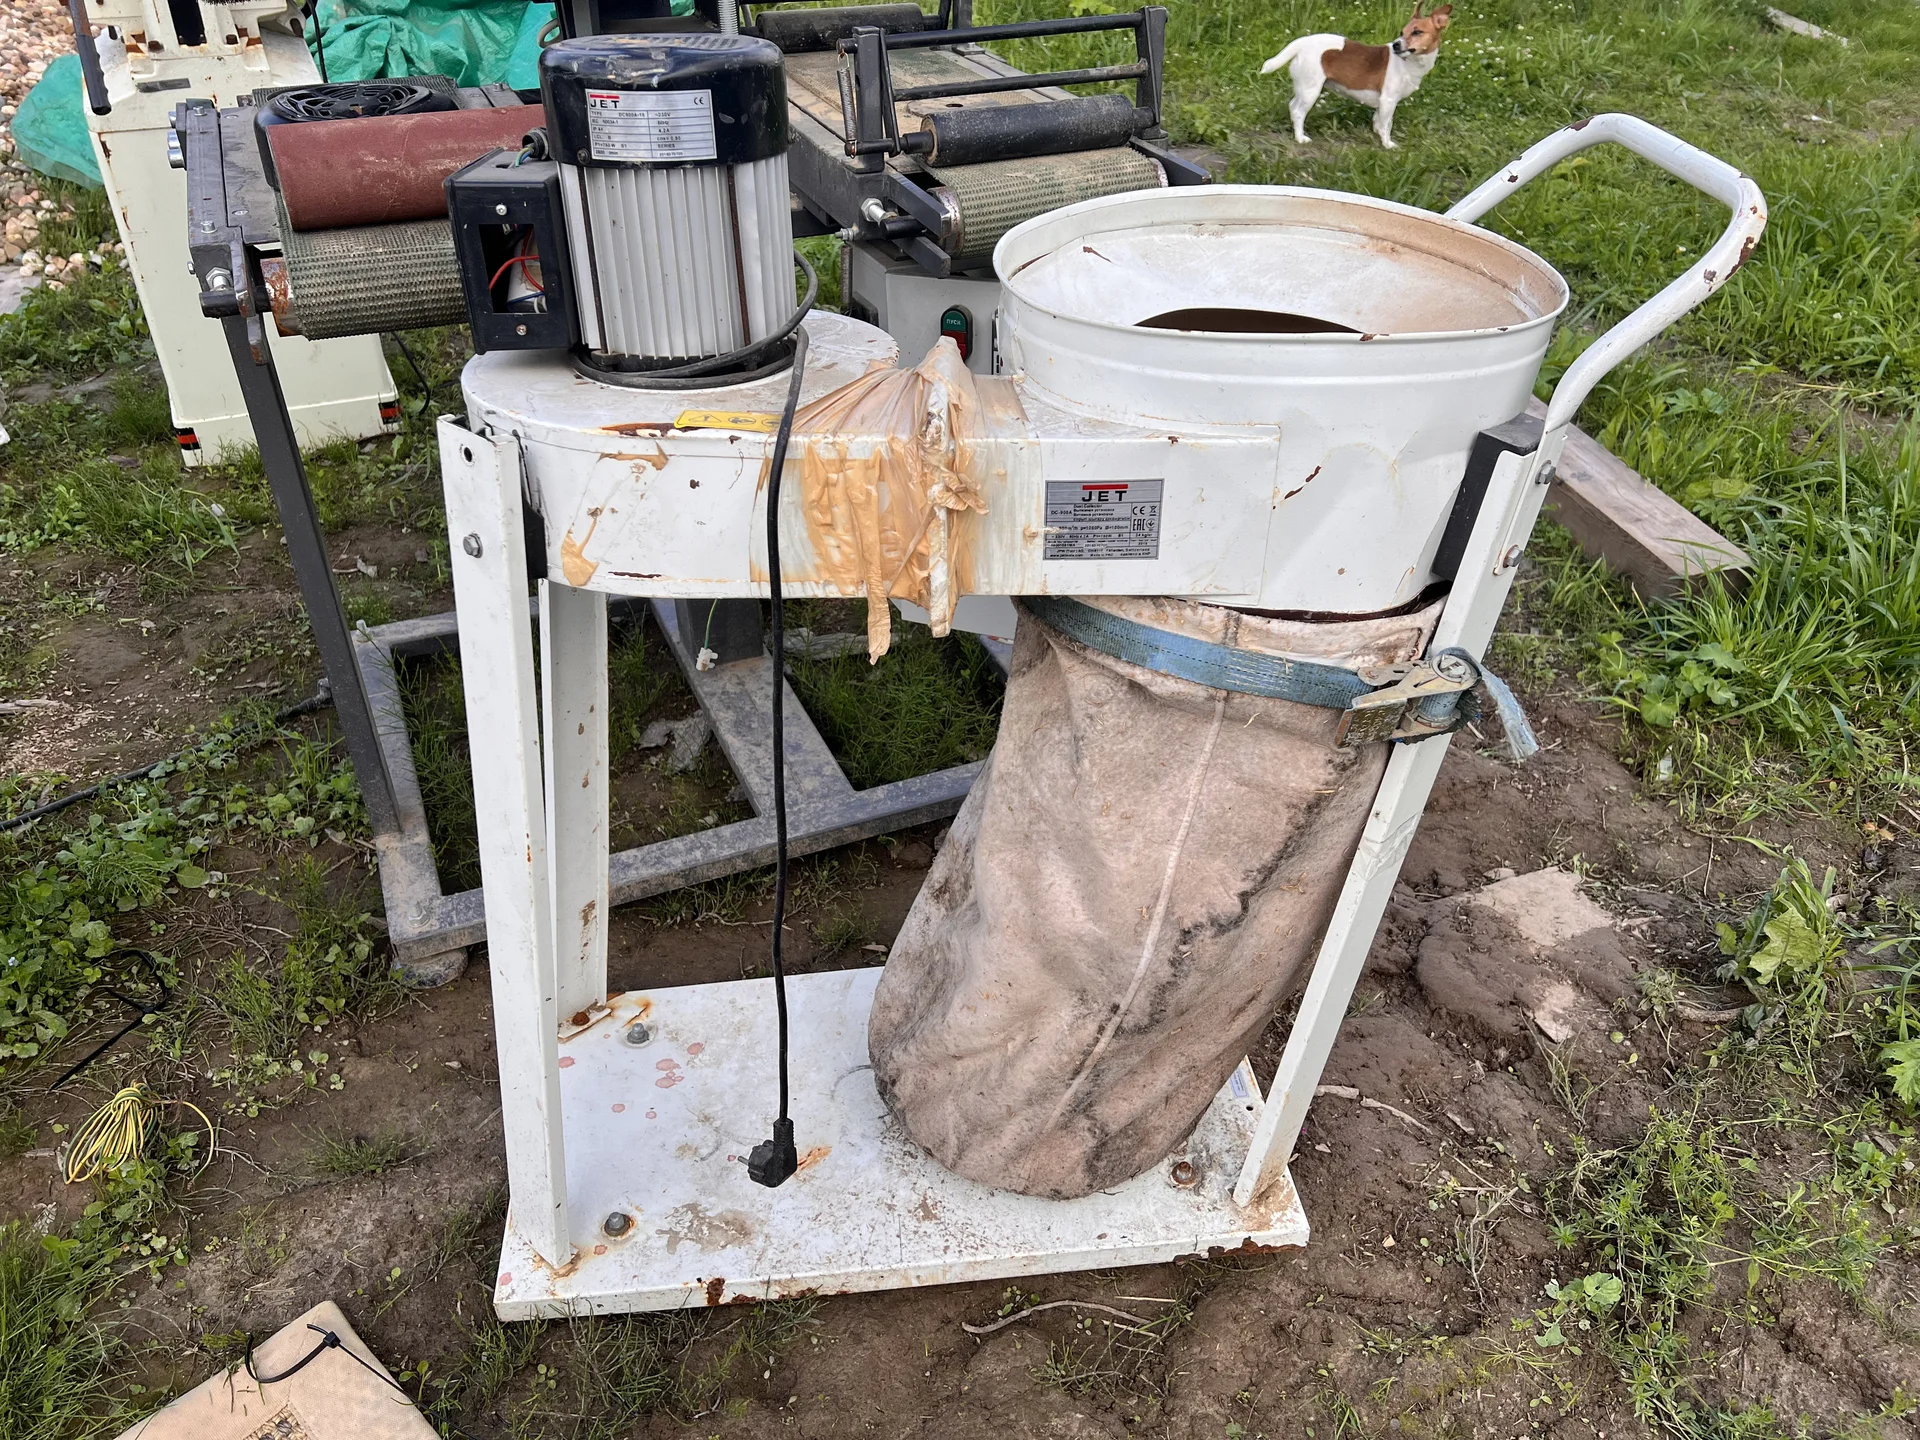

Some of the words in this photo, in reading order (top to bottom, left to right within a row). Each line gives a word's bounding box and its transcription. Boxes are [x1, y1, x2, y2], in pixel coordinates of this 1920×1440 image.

[590, 99, 619, 109] JET
[1082, 490, 1127, 502] JET
[1132, 505, 1146, 515] CE
[1132, 518, 1146, 531] EAC
